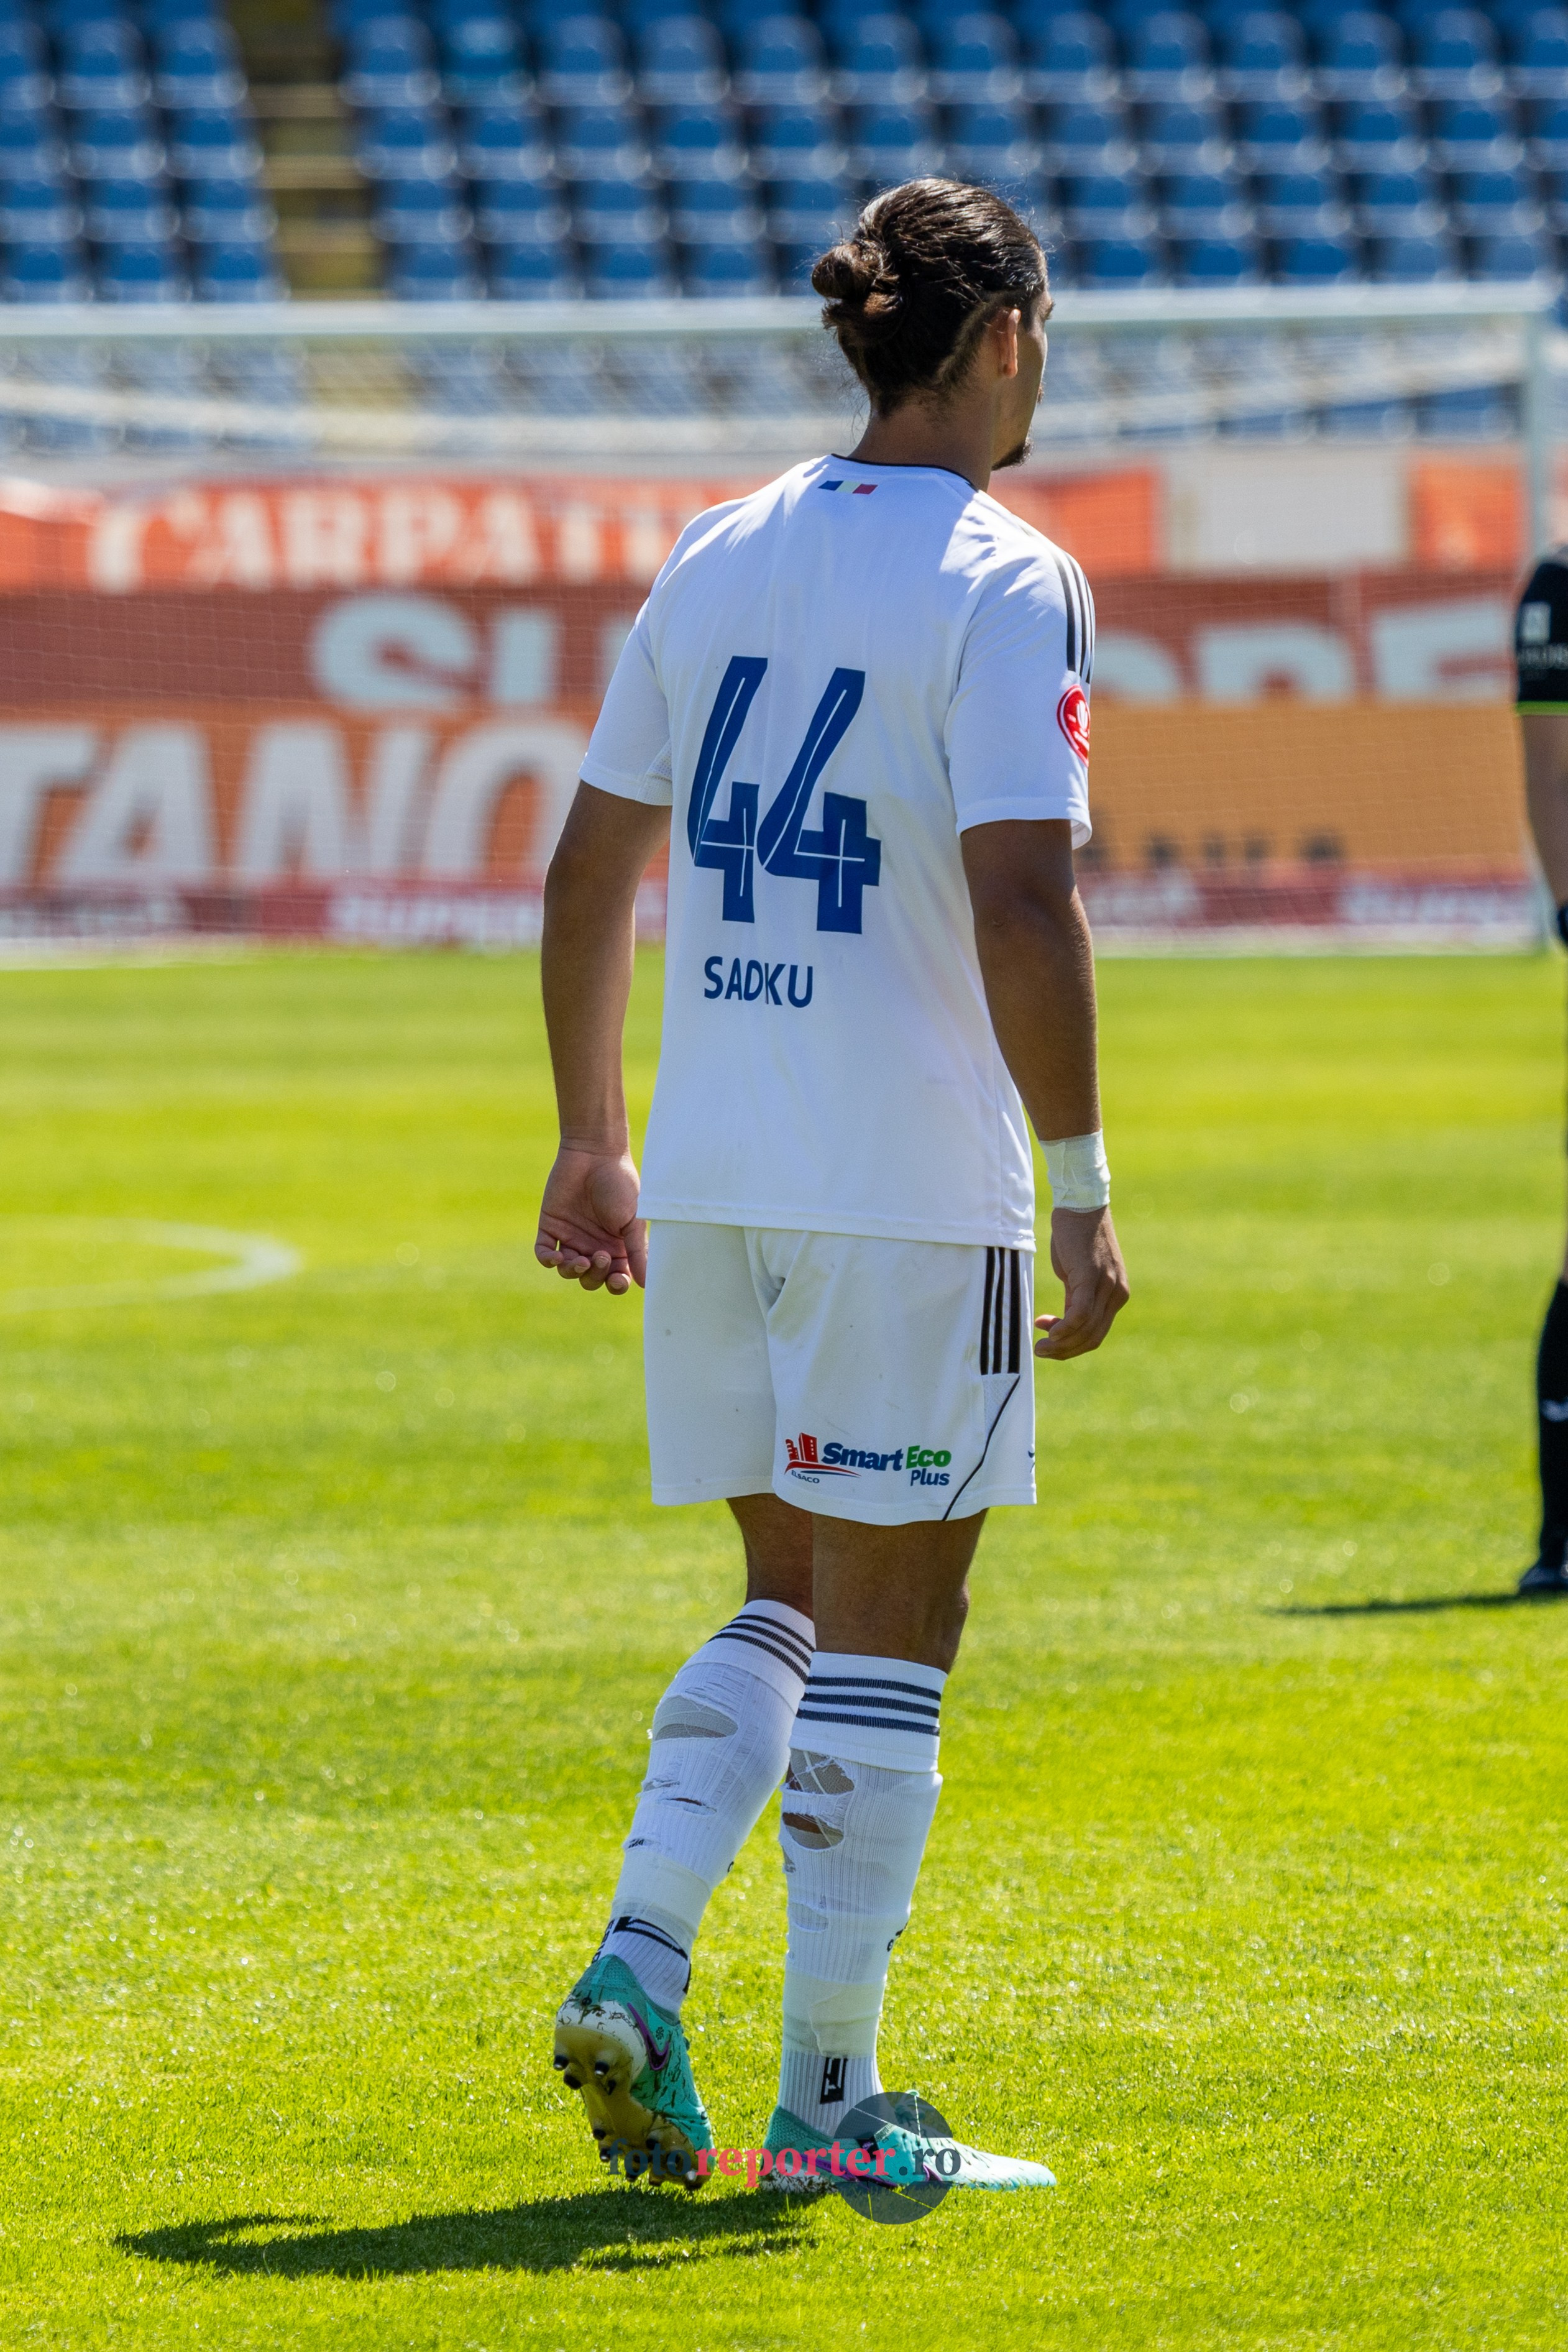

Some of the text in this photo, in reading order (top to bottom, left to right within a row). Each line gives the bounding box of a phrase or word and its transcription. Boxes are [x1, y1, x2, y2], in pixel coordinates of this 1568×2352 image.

[687, 656, 881, 934] 44
[704, 956, 814, 1008] SADKU
[791, 1470, 820, 1484] ELSACO
[910, 1468, 950, 1487] Plus
